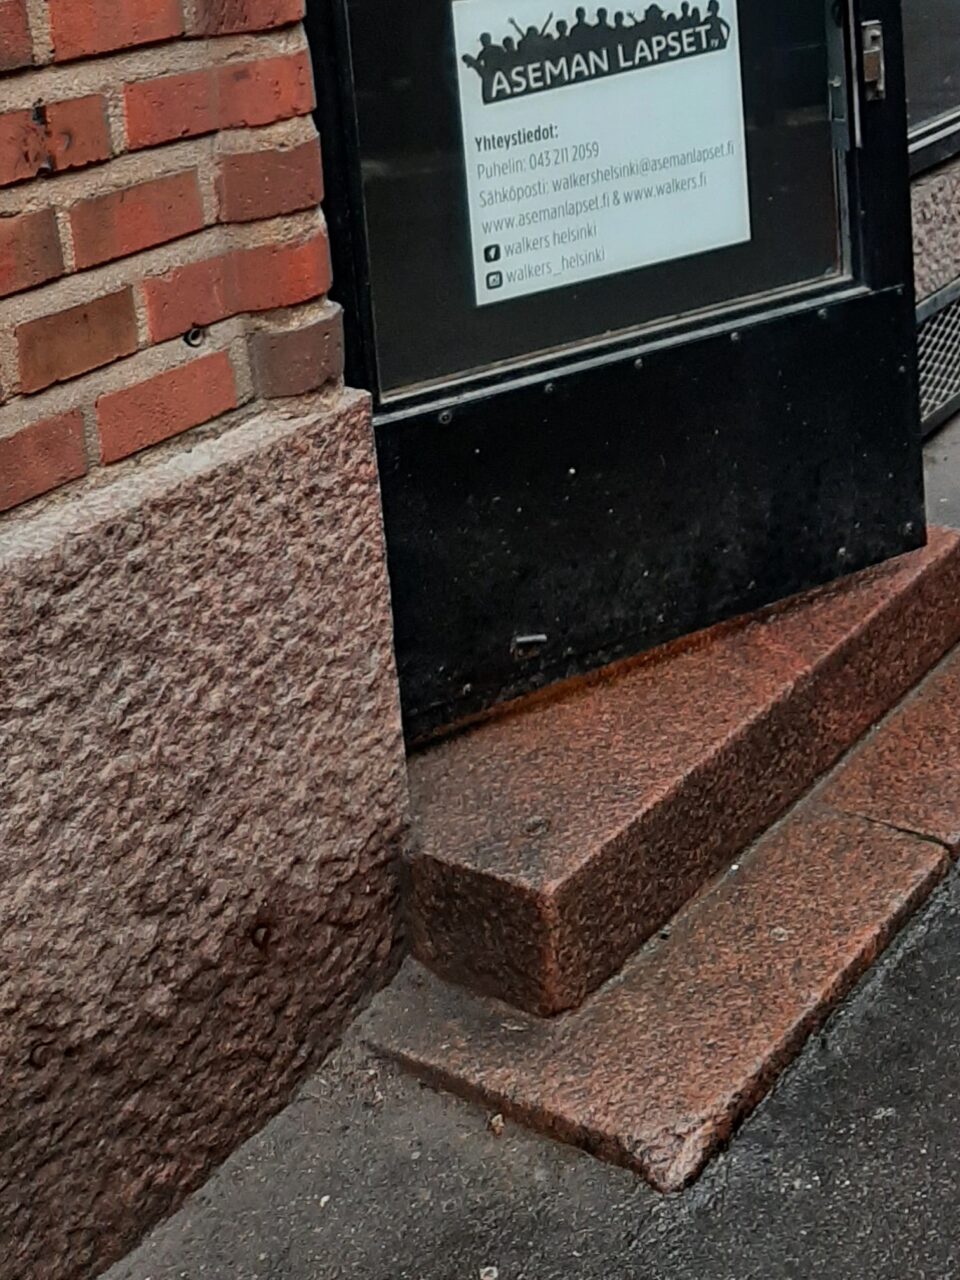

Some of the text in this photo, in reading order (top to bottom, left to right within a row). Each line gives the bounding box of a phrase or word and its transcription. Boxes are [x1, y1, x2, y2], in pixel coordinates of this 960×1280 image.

[490, 47, 609, 98] ASEMAN
[617, 24, 712, 68] LAPSET
[475, 123, 559, 153] Yhteystiedot:
[477, 158, 527, 180] Puhelin:
[529, 150, 551, 170] 043
[572, 141, 600, 162] 2059
[479, 140, 735, 208] Sähköposti: walkershelsinki@asemanlapset.fi
[482, 171, 708, 235] www.asemanlapset.fi & www.walkers.fi
[504, 224, 598, 257] walkers helsinki
[506, 246, 606, 284] walkers_helsinki
